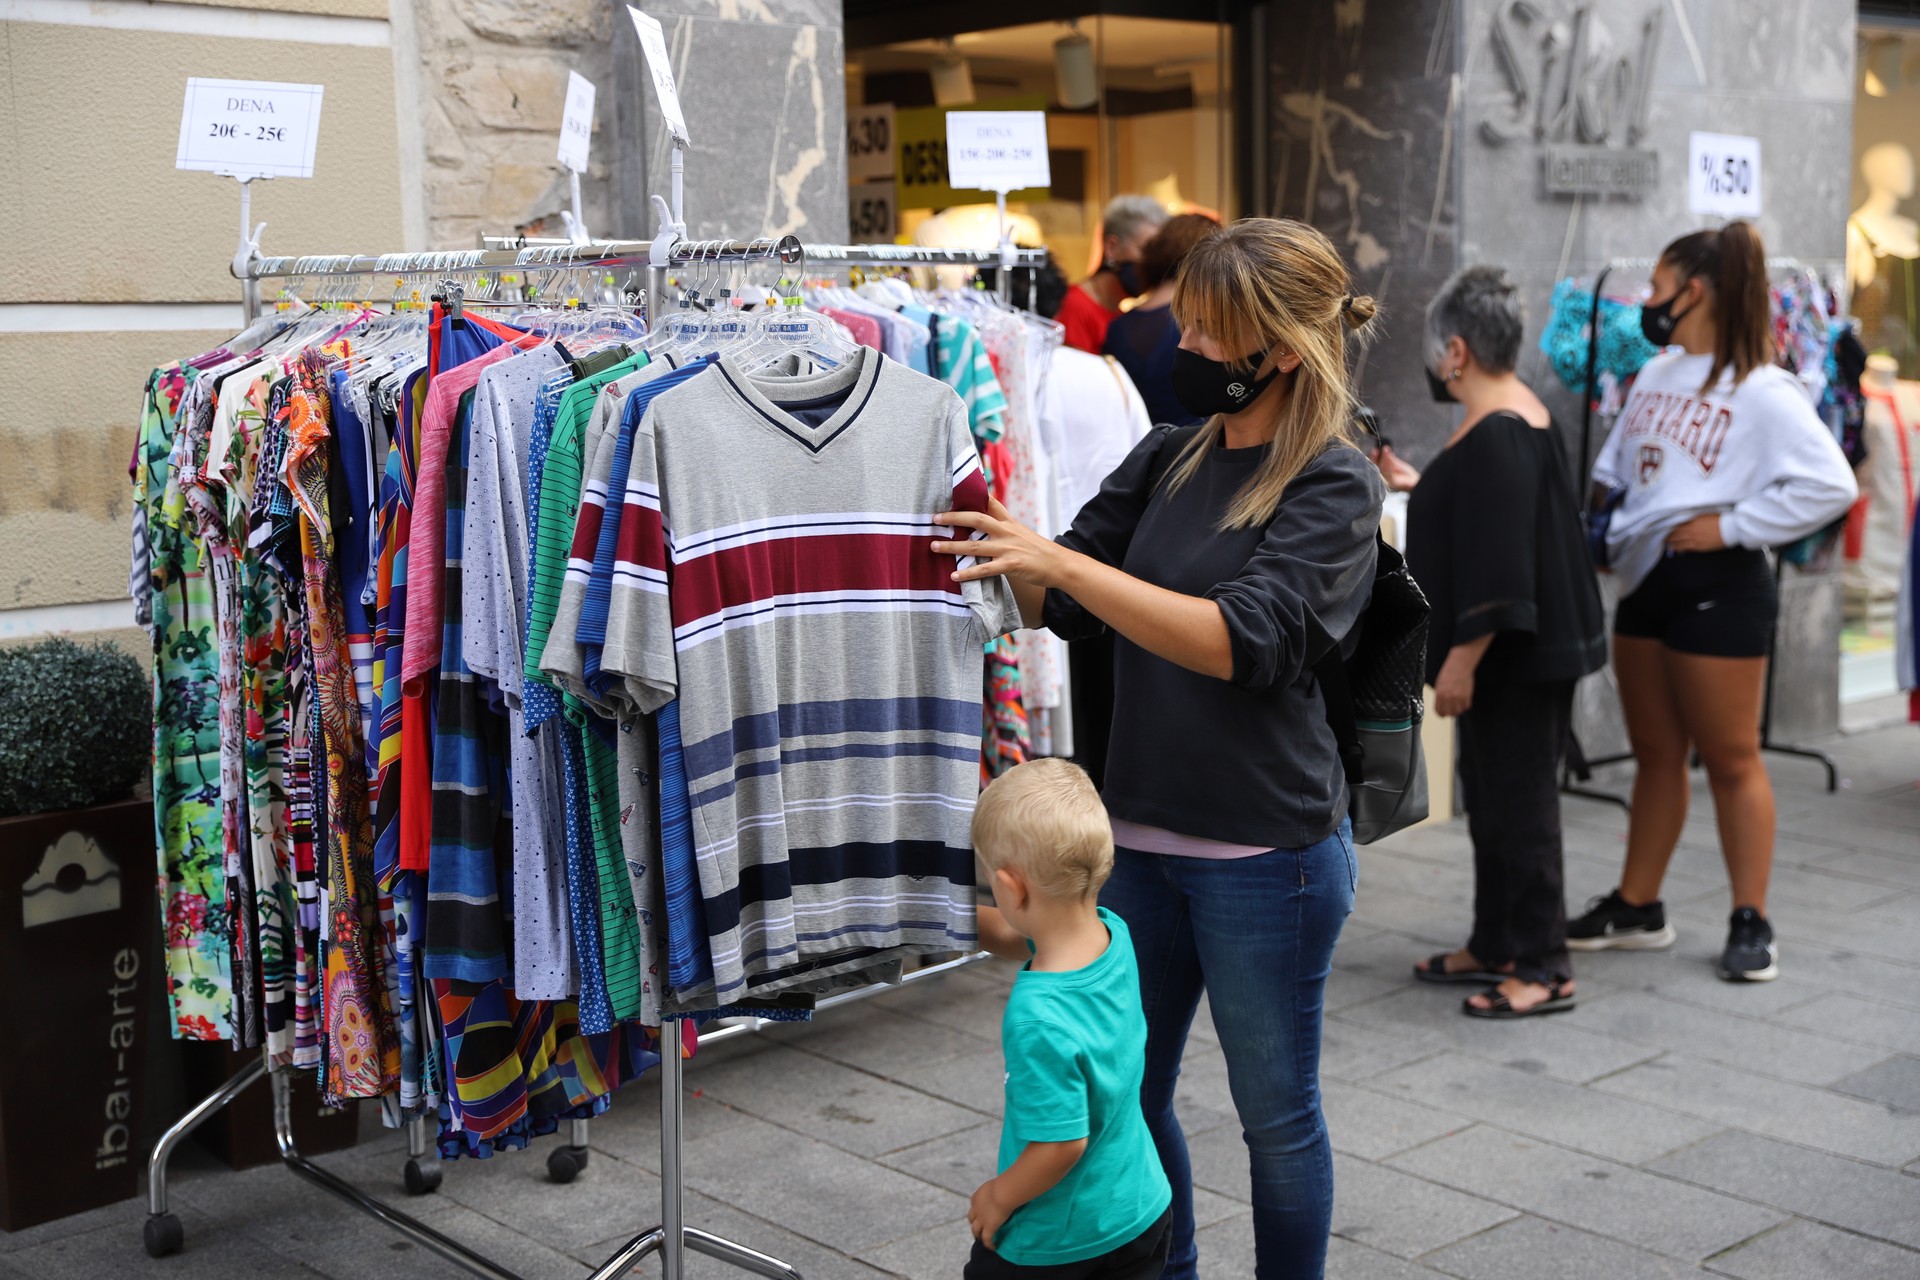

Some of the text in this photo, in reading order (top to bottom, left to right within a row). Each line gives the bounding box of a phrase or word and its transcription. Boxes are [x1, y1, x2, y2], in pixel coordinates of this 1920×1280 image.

[226, 97, 275, 114] DENA
[209, 122, 240, 138] 20€
[256, 126, 288, 142] 25€
[1700, 154, 1753, 196] %50
[96, 948, 140, 1170] ibai-arte
